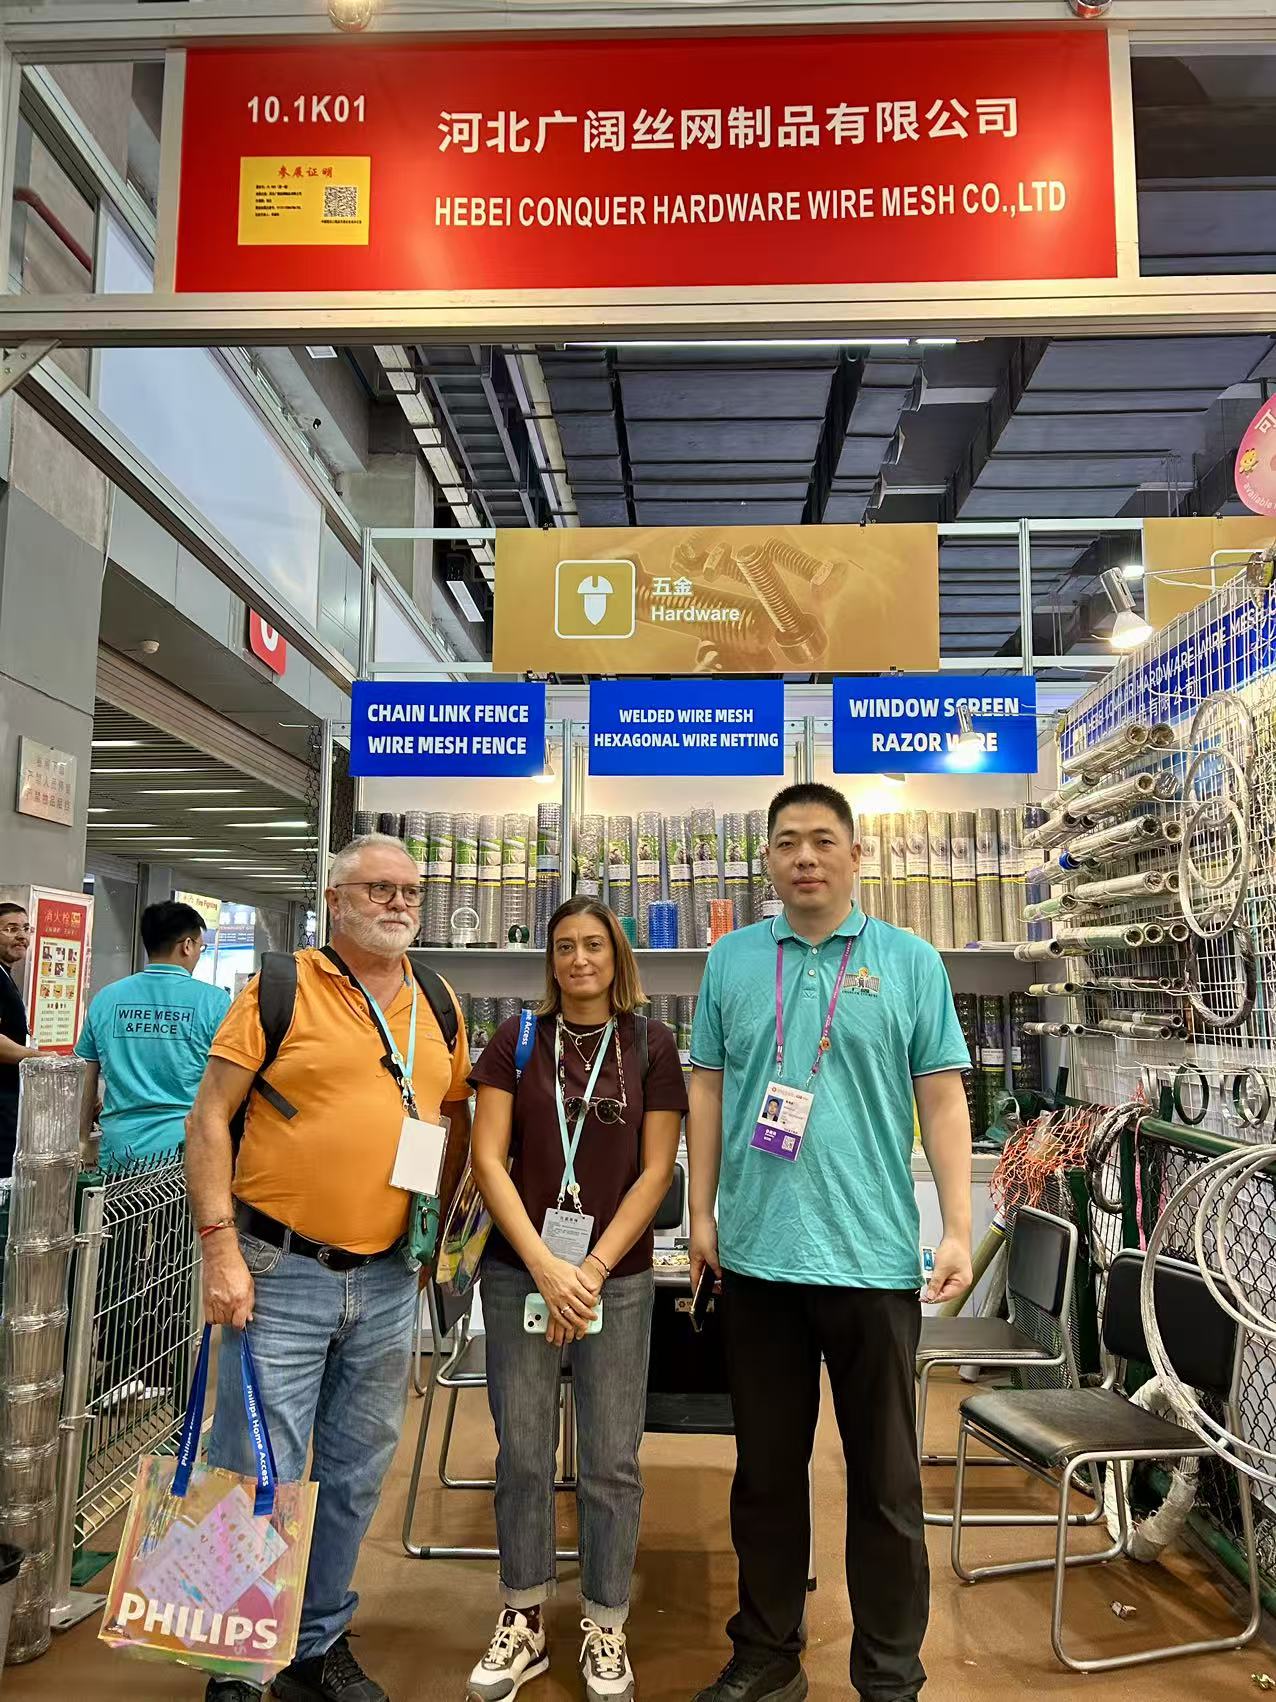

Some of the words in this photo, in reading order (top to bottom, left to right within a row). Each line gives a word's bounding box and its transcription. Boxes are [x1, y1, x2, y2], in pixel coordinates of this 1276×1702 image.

[247, 95, 365, 123] 10.1K01
[436, 97, 1019, 154] 河北广阔丝网制品有限公司
[435, 196, 511, 226] HEBEI
[518, 195, 647, 228] CONQUER
[653, 191, 801, 224] HARDWARE
[807, 188, 874, 220] WIRE
[881, 184, 955, 217] MESH
[962, 180, 1067, 219] CO.,LTD
[1243, 481, 1273, 509] available
[652, 576, 693, 596] 五金
[651, 606, 740, 621] Hardware
[367, 704, 425, 723] CHAIN
[429, 704, 471, 723] LINK
[475, 705, 529, 723] FENCE
[619, 709, 675, 723] WELDED
[677, 709, 712, 723] WIRE
[715, 709, 753, 723] MESH
[849, 698, 940, 718] WINDOW
[367, 736, 414, 754] WIRE
[417, 736, 468, 755] MESH
[472, 736, 527, 755] FENCE
[594, 733, 680, 747] HEXAGONAL
[682, 733, 717, 747] WIRE
[720, 733, 779, 747] NETTING
[872, 732, 943, 752] RAZOR
[118, 1009, 151, 1020] WIRE
[154, 1009, 190, 1022] MESH
[126, 1022, 178, 1035] &FENCE
[521, 1021, 532, 1046] Access
[253, 1420, 264, 1450] Home
[259, 1451, 269, 1487] Access
[116, 1592, 278, 1650] PHILIPS
